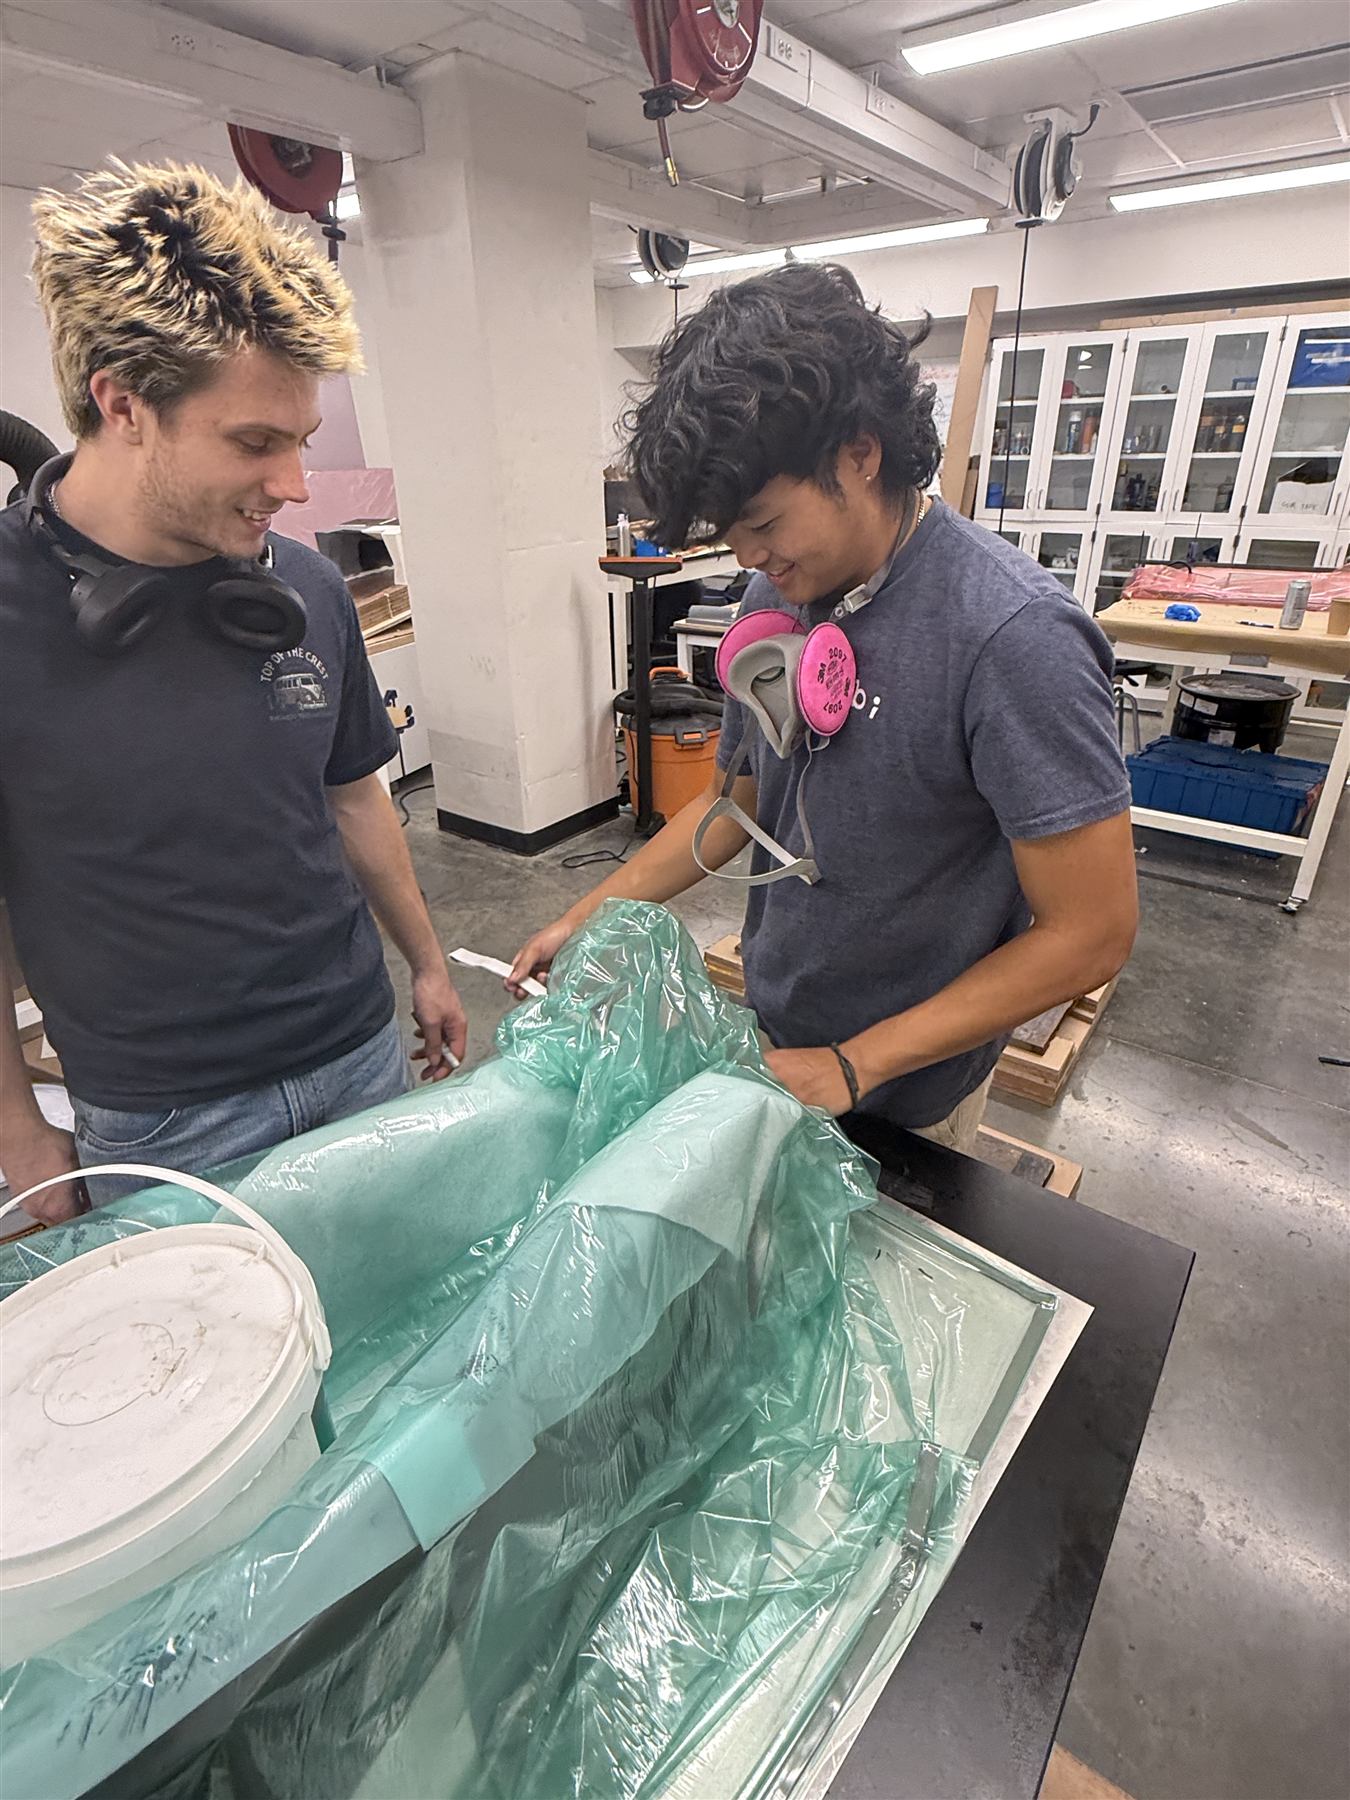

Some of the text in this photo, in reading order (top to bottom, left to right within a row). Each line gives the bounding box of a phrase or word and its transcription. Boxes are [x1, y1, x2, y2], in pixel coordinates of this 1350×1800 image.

[828, 647, 847, 663] 2097
[260, 661, 275, 682] TOP
[305, 652, 329, 680] CREST
[817, 662, 827, 684] 3M
[823, 700, 843, 714] 2097
